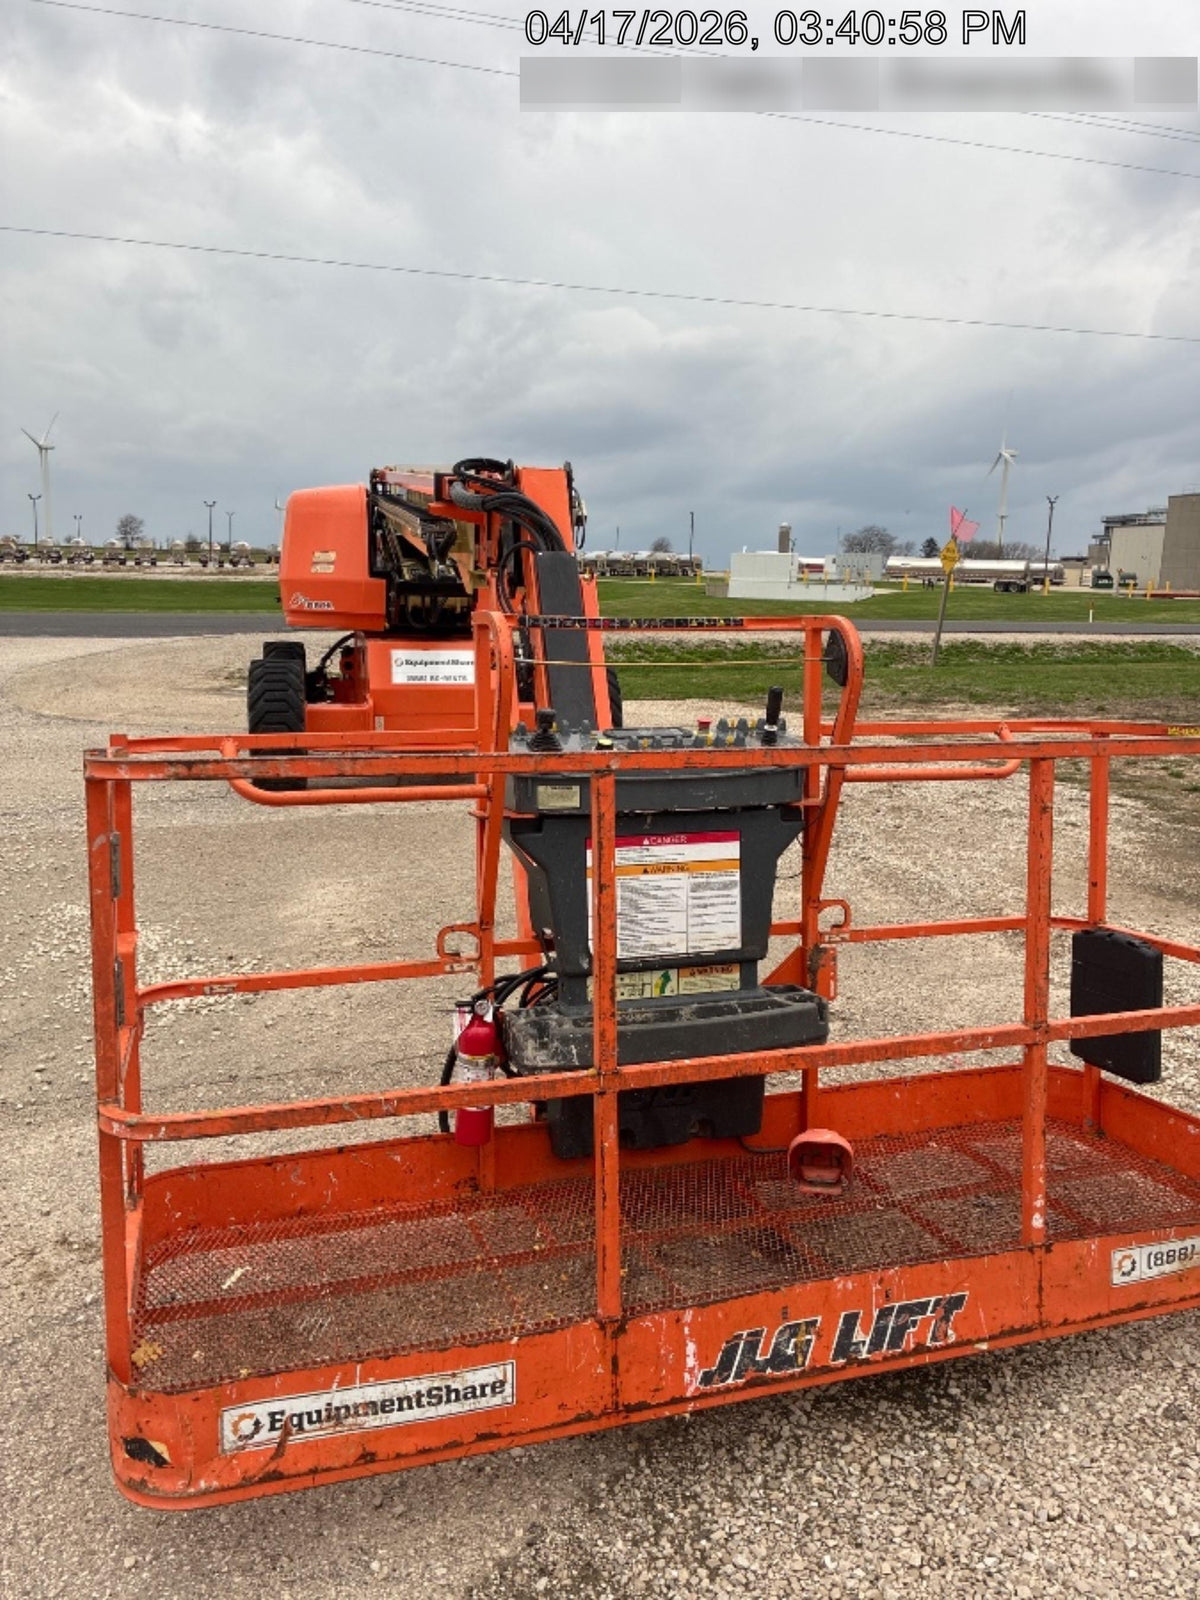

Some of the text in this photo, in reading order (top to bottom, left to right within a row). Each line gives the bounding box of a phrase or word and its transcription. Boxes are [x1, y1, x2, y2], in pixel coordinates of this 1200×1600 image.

[1147, 1244, 1196, 1270] (888)
[830, 1291, 969, 1363] LIFT
[267, 1386, 506, 1431] EquipmentShare
